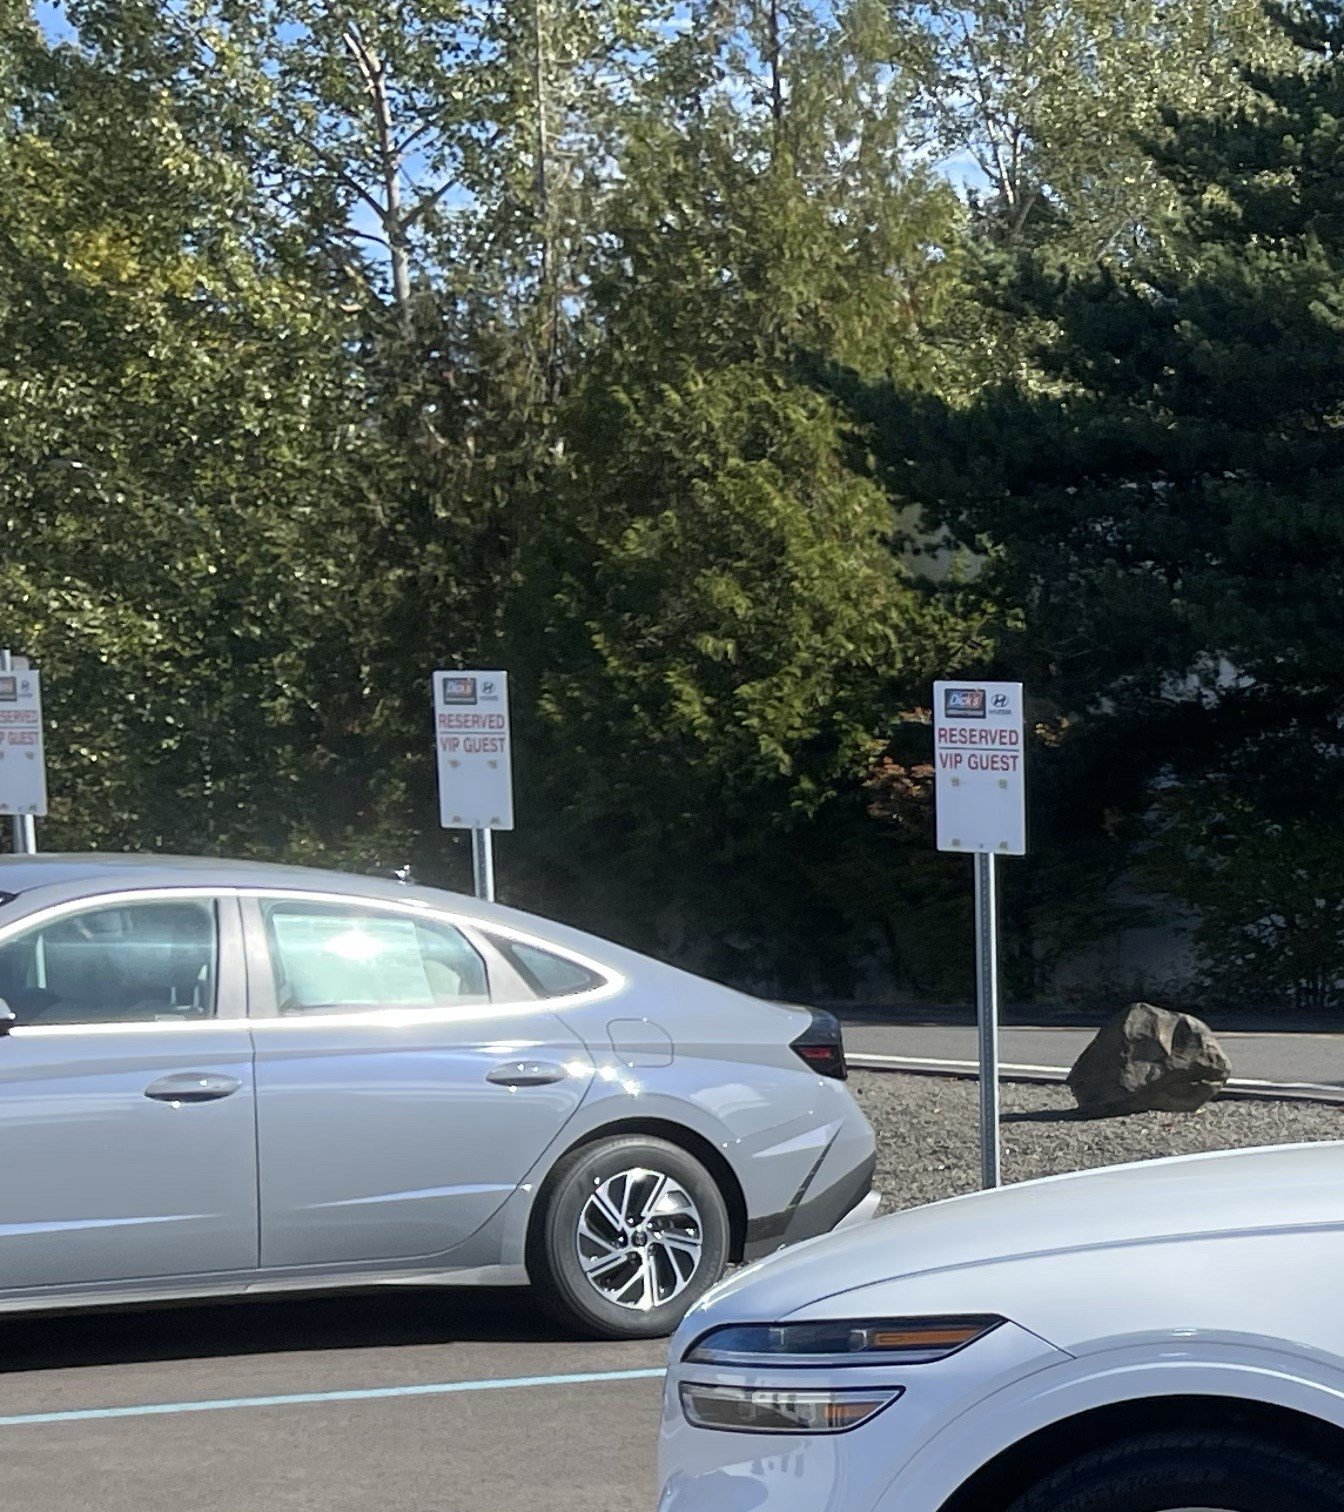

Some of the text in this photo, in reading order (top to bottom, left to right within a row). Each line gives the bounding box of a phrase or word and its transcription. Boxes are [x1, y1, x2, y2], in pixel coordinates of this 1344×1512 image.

[439, 713, 504, 729] RESERVED
[938, 728, 1019, 745] RESERVED
[441, 737, 505, 753] VIP GUEST
[939, 753, 1019, 771] VIP GUEST
